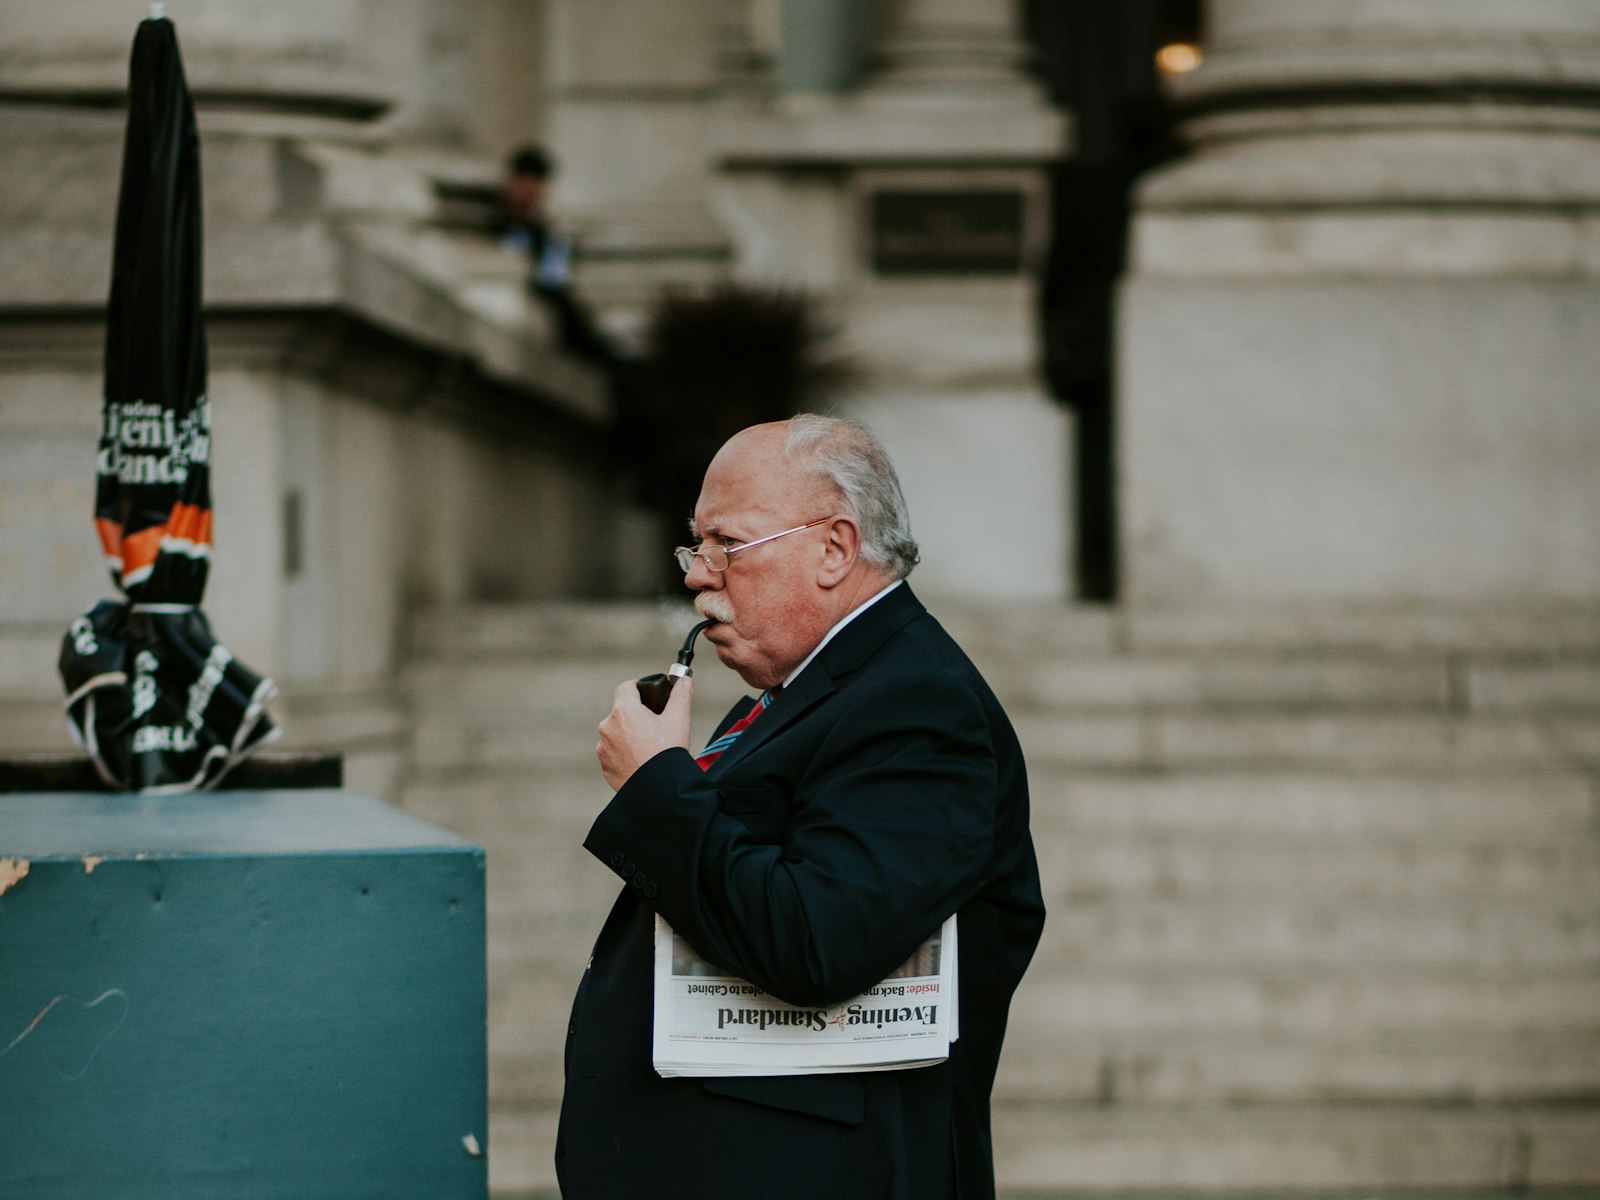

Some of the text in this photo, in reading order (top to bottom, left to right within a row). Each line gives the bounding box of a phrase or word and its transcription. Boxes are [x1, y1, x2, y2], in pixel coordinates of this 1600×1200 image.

[687, 984, 727, 996] Cabinet
[729, 985, 739, 996] to
[880, 986, 904, 997] Back
[906, 983, 939, 994] Inside:
[718, 1004, 937, 1031] Evening Standard
